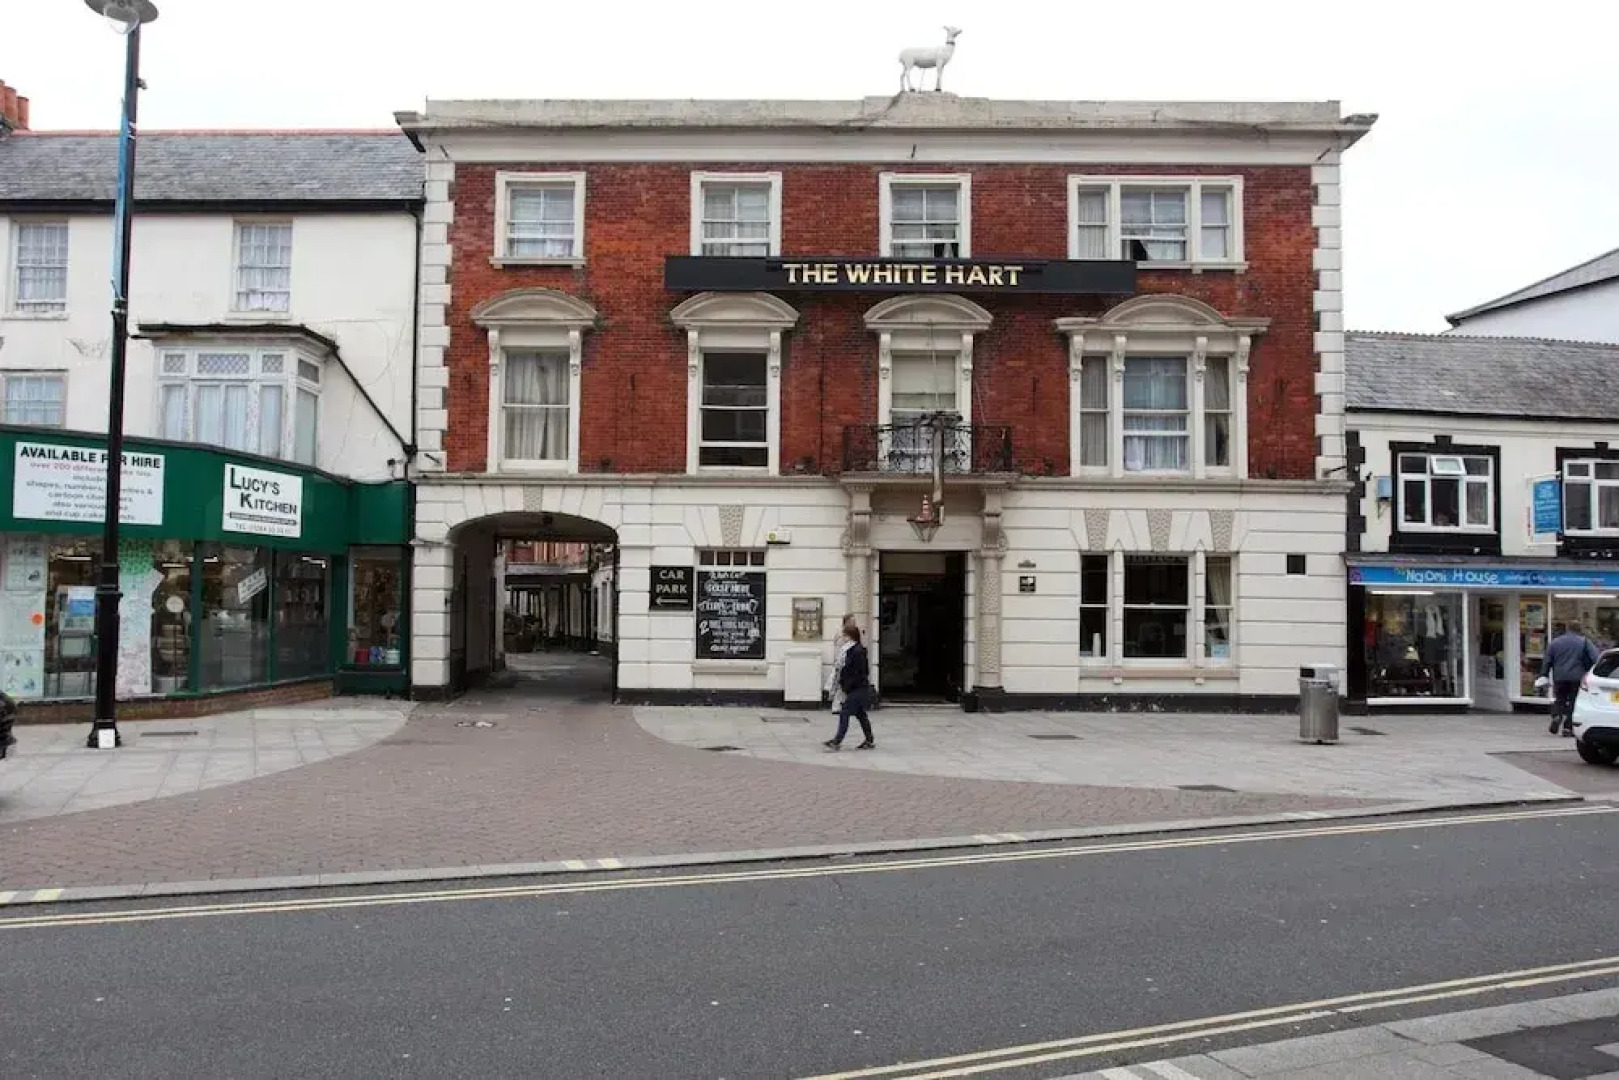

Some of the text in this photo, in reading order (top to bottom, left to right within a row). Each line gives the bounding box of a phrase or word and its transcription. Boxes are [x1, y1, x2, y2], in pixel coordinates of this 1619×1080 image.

[782, 263, 1023, 286] THE WHITE HART
[20, 446, 161, 469] AVAILABLE FR HIRE
[54, 462, 71, 471] 200
[230, 467, 281, 496] LUCY'S
[240, 492, 297, 515] KITCHEN
[659, 569, 685, 580] CAR
[1452, 568, 1499, 584] House
[655, 583, 688, 594] PARK
